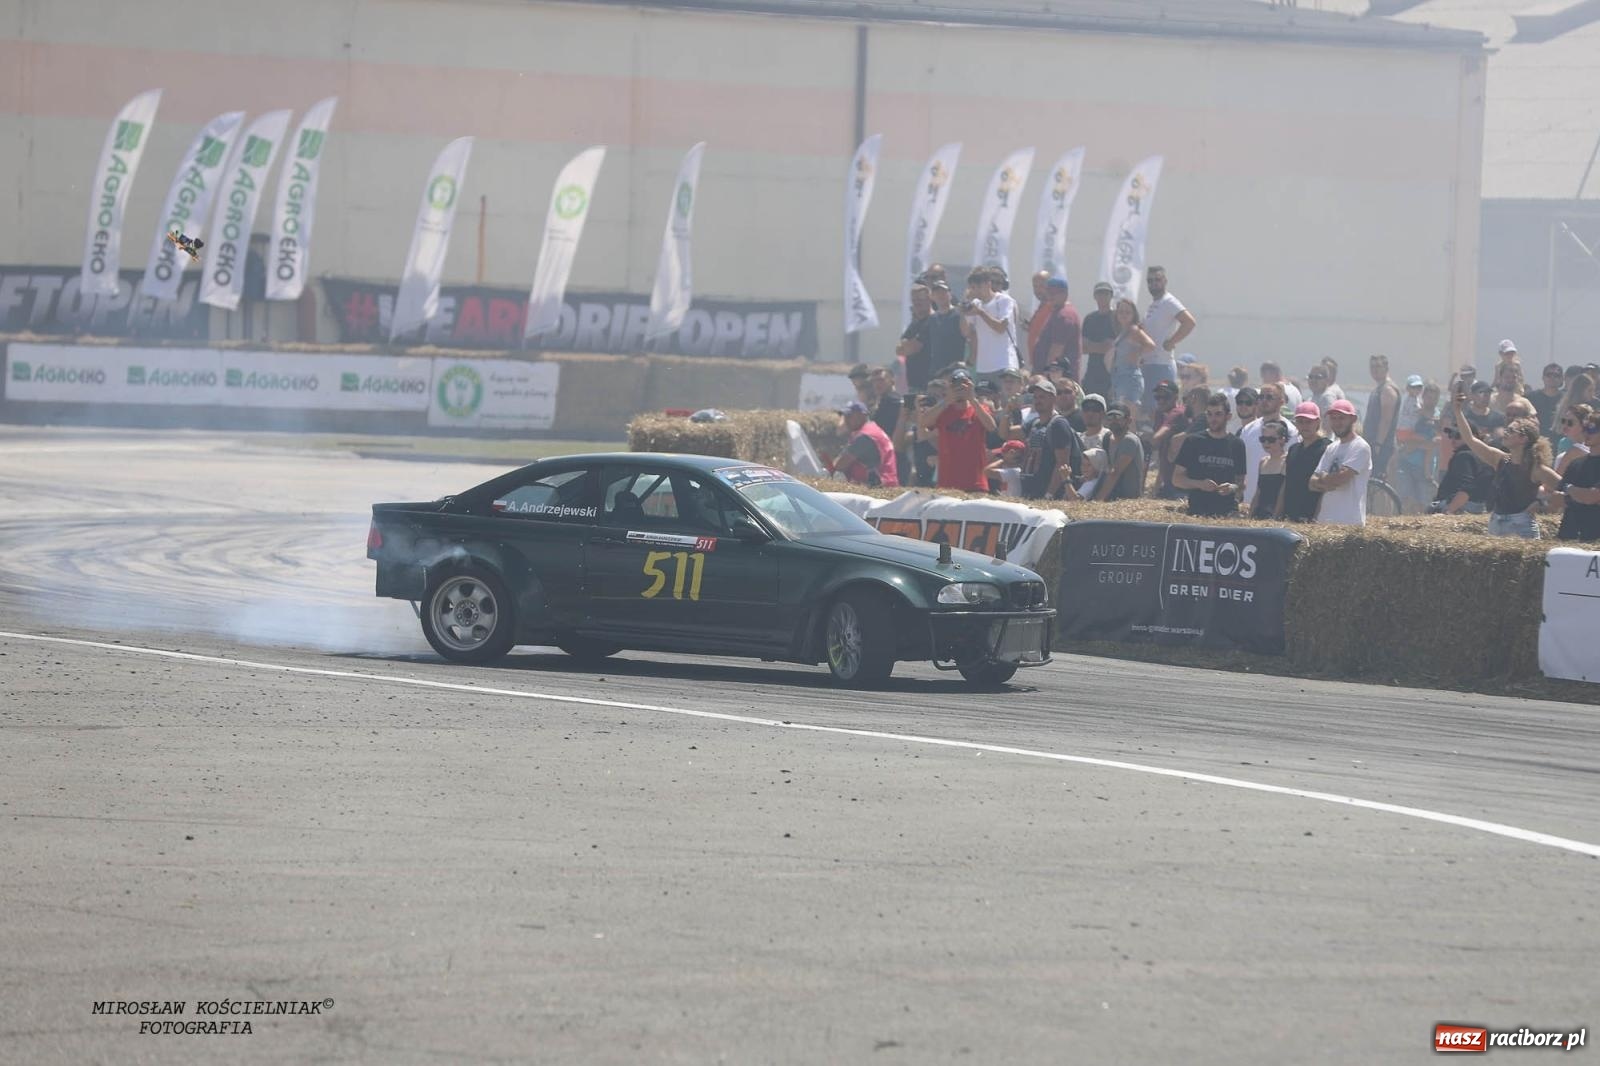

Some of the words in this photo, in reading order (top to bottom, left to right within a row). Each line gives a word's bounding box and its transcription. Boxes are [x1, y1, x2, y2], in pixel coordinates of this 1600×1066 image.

[90, 155, 128, 275] AGROEKO
[213, 168, 256, 287] AGROEKO
[277, 162, 310, 281] AGROEKO
[696, 539, 713, 550] 511
[1091, 544, 1125, 558] AUTO
[1132, 544, 1157, 558] FUS
[1172, 538, 1257, 579] INEOS
[640, 551, 705, 601] 511
[1098, 570, 1144, 584] GROUP
